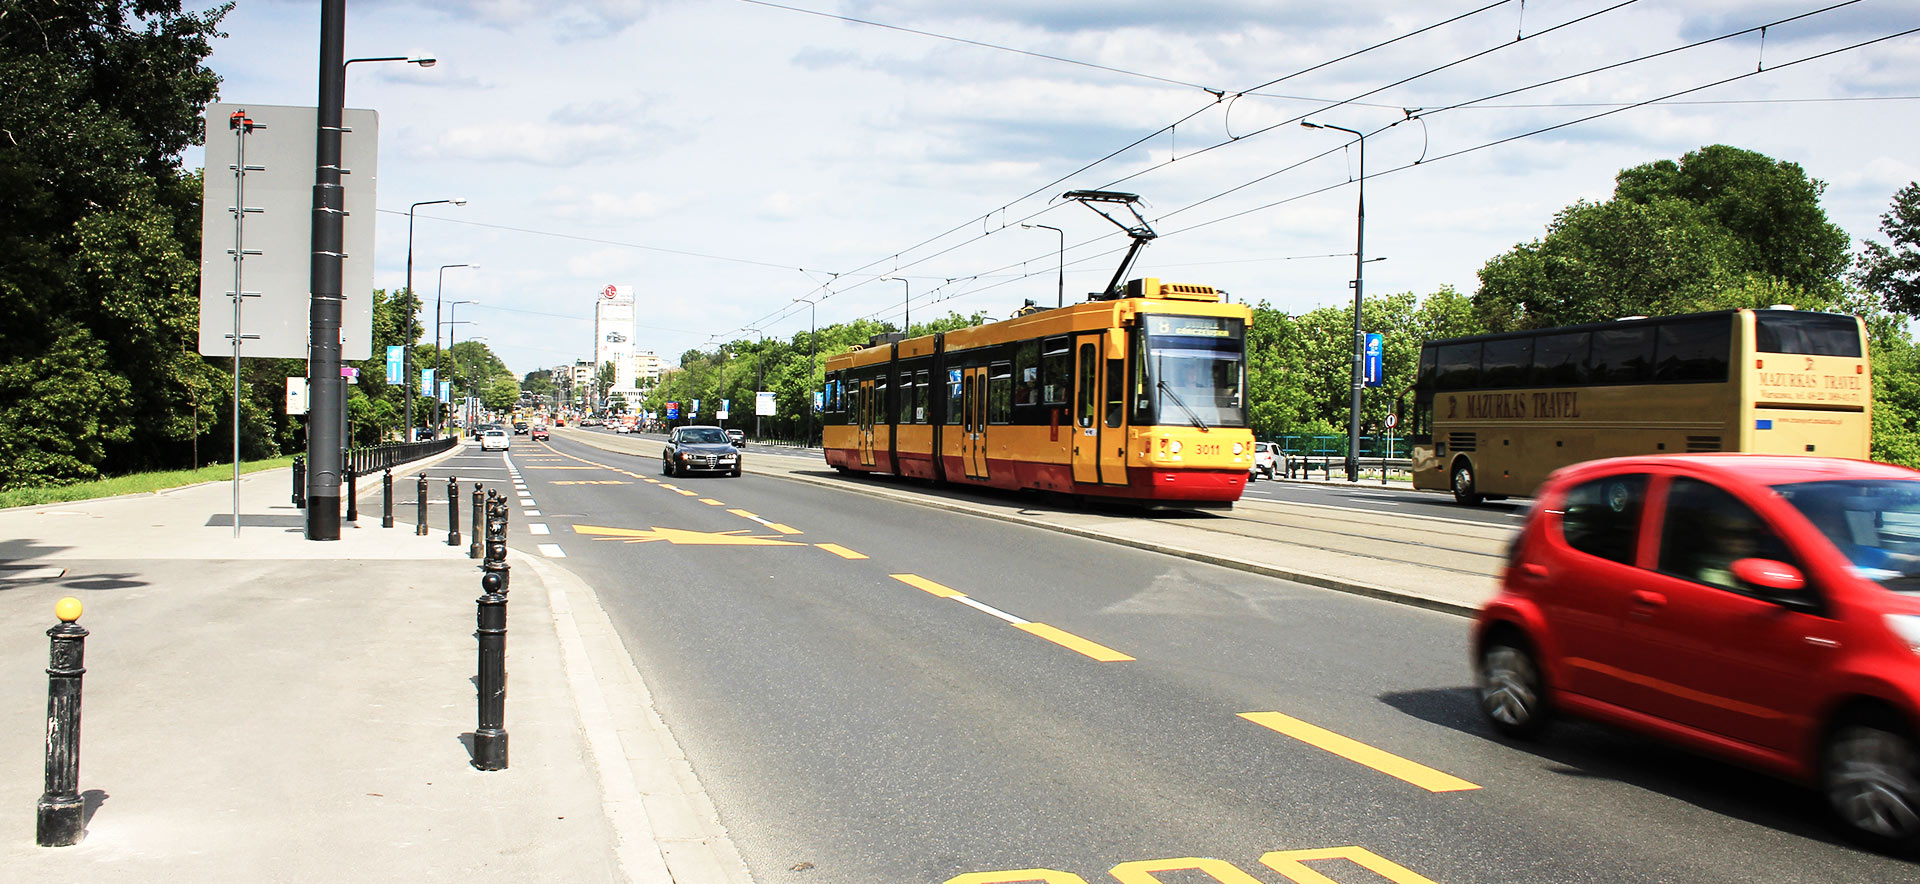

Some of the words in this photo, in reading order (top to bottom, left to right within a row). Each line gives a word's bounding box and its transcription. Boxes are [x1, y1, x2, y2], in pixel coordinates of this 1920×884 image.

[1759, 372, 1817, 388] MAZURKAS
[1823, 375, 1861, 391] TRAVEL
[1465, 393, 1526, 418] MAZURKAS
[1532, 391, 1580, 418] TRAVEL
[1195, 444, 1220, 455] 3011
